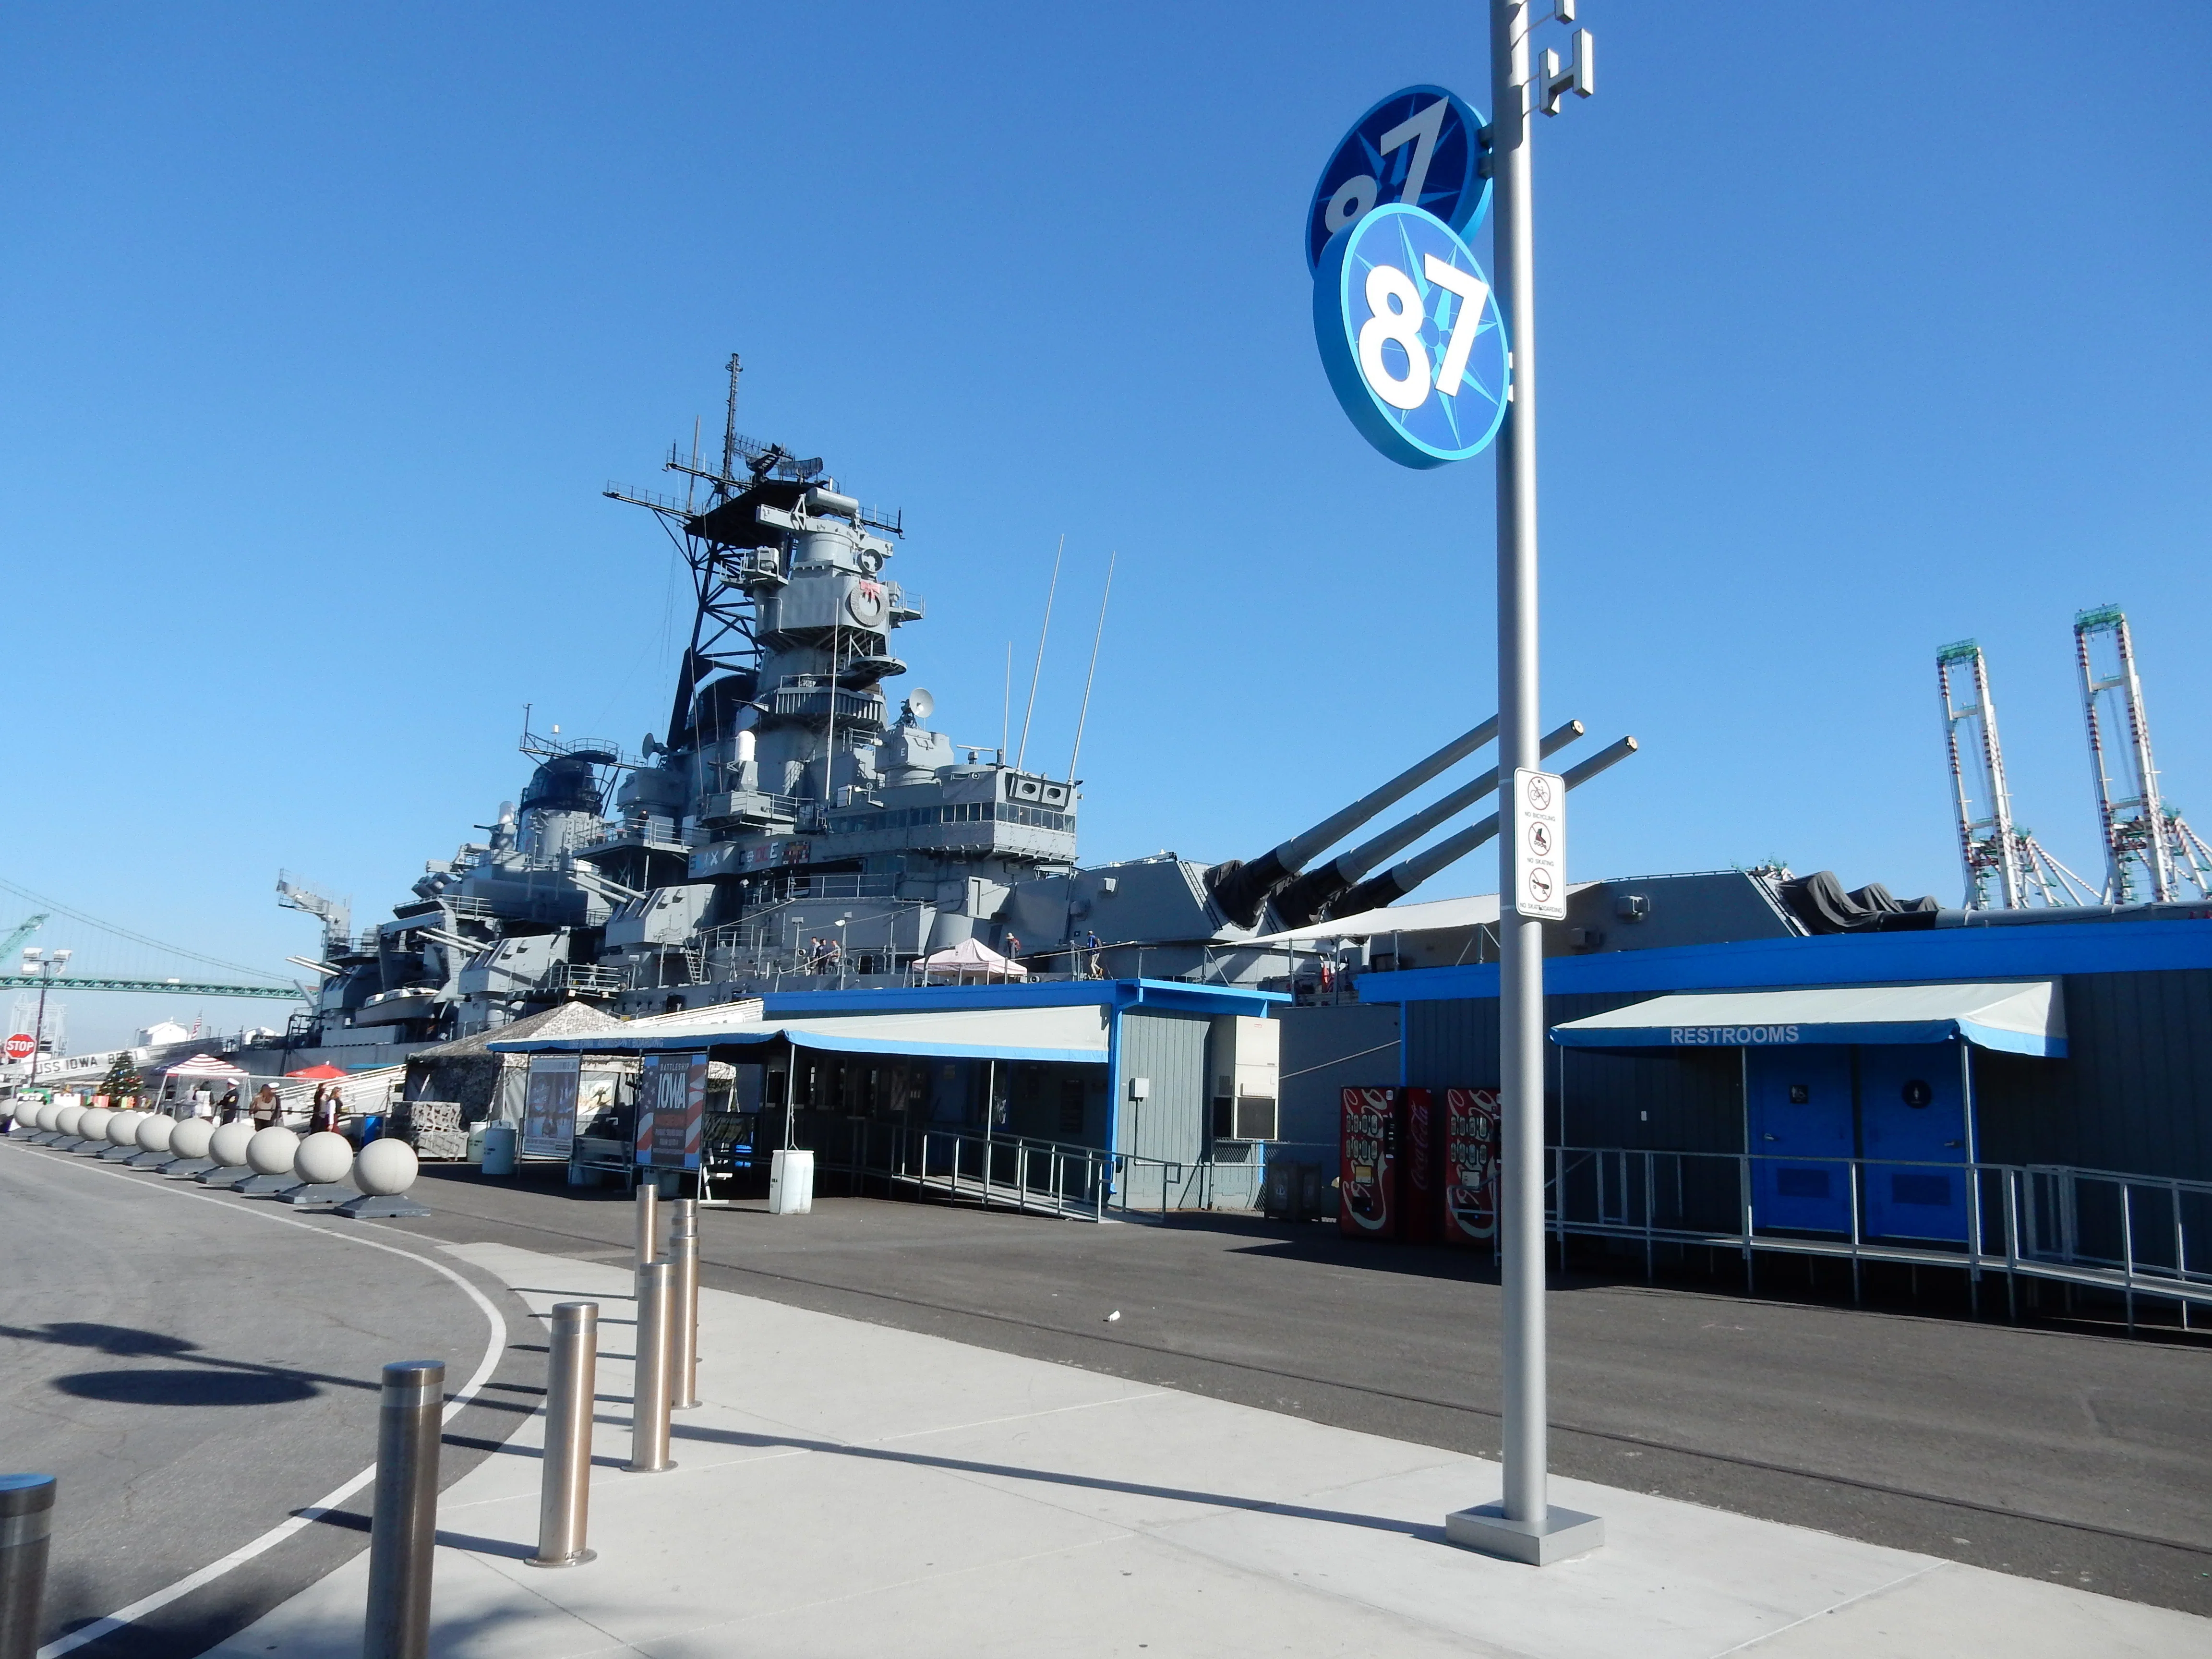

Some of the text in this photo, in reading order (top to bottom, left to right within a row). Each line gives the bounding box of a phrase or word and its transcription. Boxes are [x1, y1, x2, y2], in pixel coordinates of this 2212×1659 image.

[1358, 253, 1489, 410] 87
[1533, 812, 1555, 821] BICYCLING
[1670, 1025, 1800, 1044] RESTROOMS
[7, 1040, 35, 1051] STOP
[66, 1057, 98, 1070] IOWA
[660, 1062, 689, 1071] BATTLESHIP
[657, 1072, 686, 1109] IOWA
